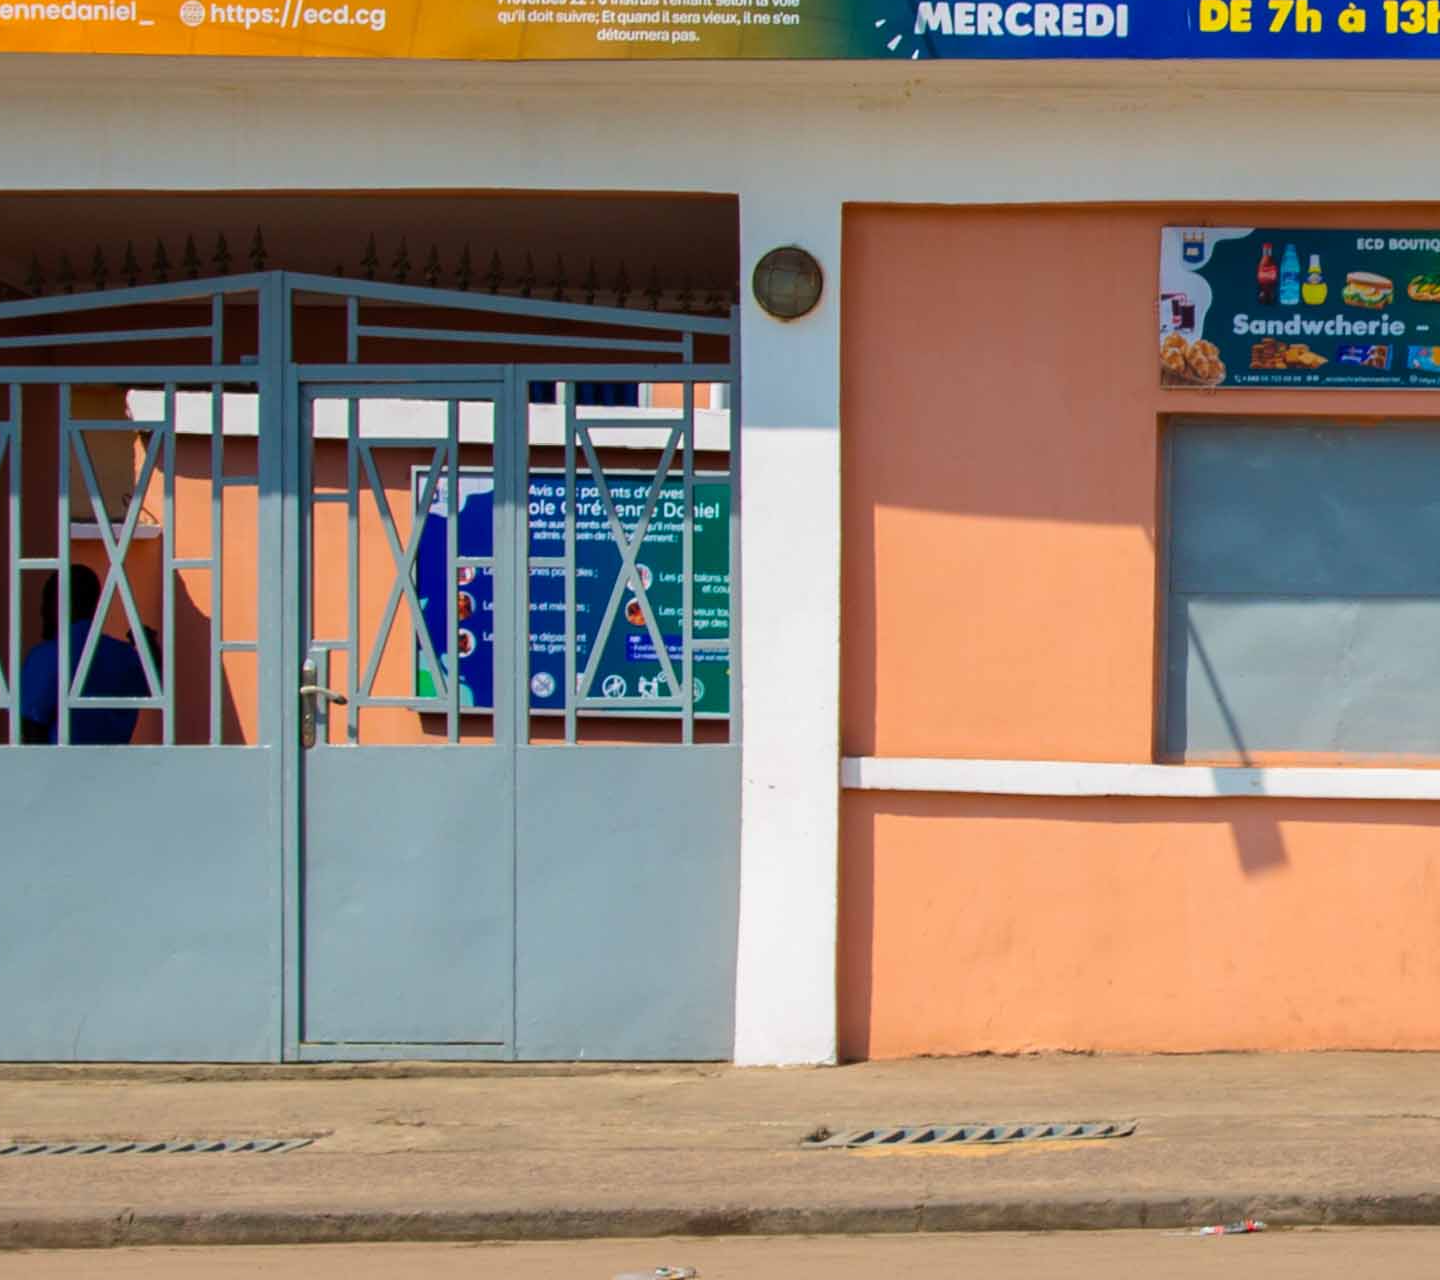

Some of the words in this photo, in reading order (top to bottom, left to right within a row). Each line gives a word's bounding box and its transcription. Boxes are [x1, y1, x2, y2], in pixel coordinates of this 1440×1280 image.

[210, 0, 387, 31] https://ecd.cg
[528, 9, 554, 23] doit
[617, 10, 660, 25] quand
[671, 12, 701, 24] sera
[753, 13, 770, 24] ne
[914, 2, 1128, 38] MERCREDI
[1198, 0, 1252, 33] DE
[1267, 0, 1322, 34] 7h
[1337, 3, 1365, 34] à
[596, 27, 669, 42] détournera
[1356, 237, 1385, 251] ECD
[1232, 313, 1406, 337] Sandwcherie
[528, 484, 553, 497] Avis
[581, 486, 632, 500] pants
[528, 500, 556, 516] ole
